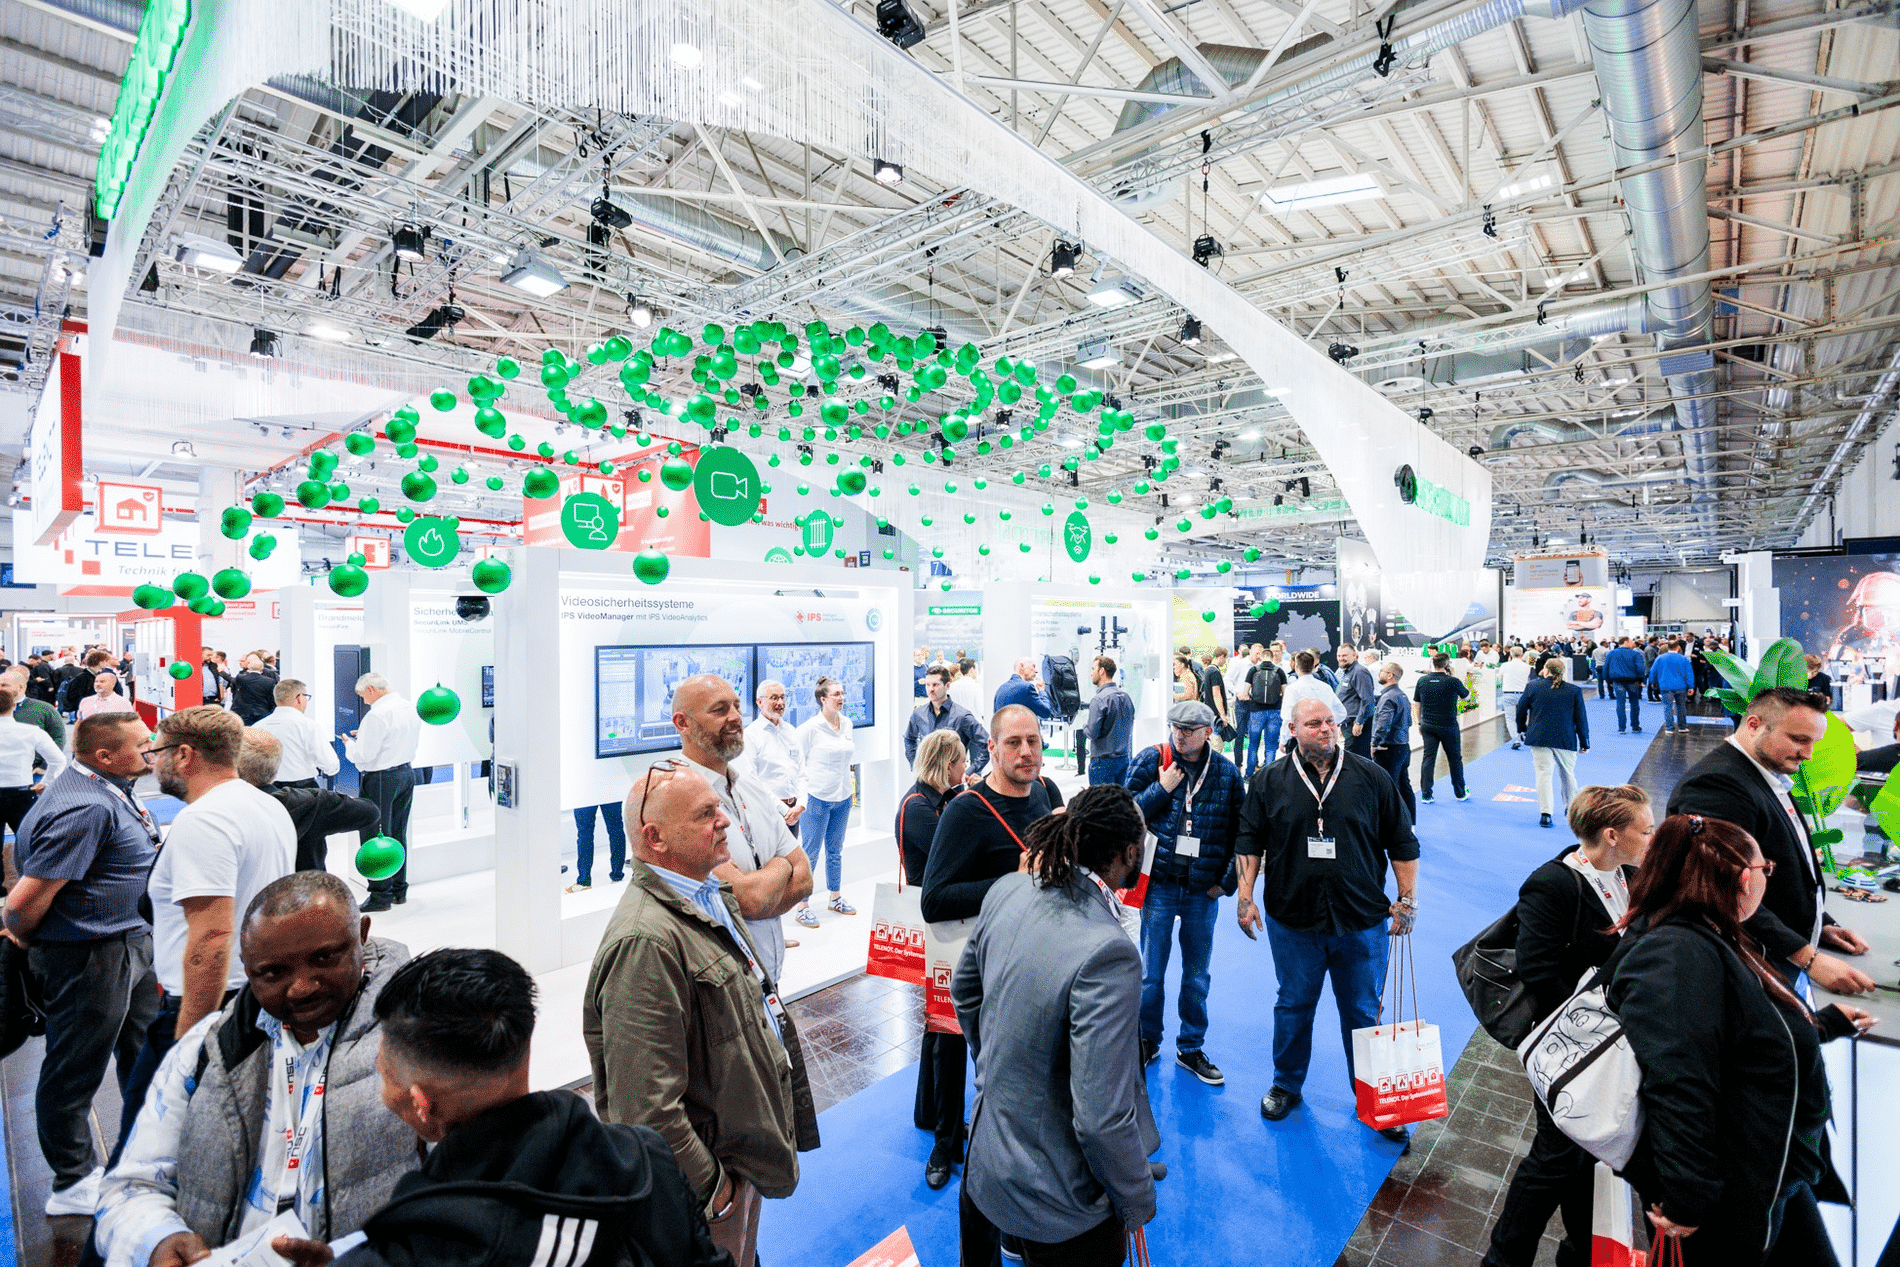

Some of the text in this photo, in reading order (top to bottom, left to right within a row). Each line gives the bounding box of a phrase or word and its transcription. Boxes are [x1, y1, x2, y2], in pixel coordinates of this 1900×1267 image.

[84, 539, 193, 559] TELE
[560, 595, 695, 611] Videosicherheitssysteme
[560, 612, 575, 620] IPS
[577, 612, 634, 622] VideoManager
[662, 613, 708, 623] VideoAnalytics
[807, 612, 822, 622] IPS
[933, 994, 953, 1004] TELEN
